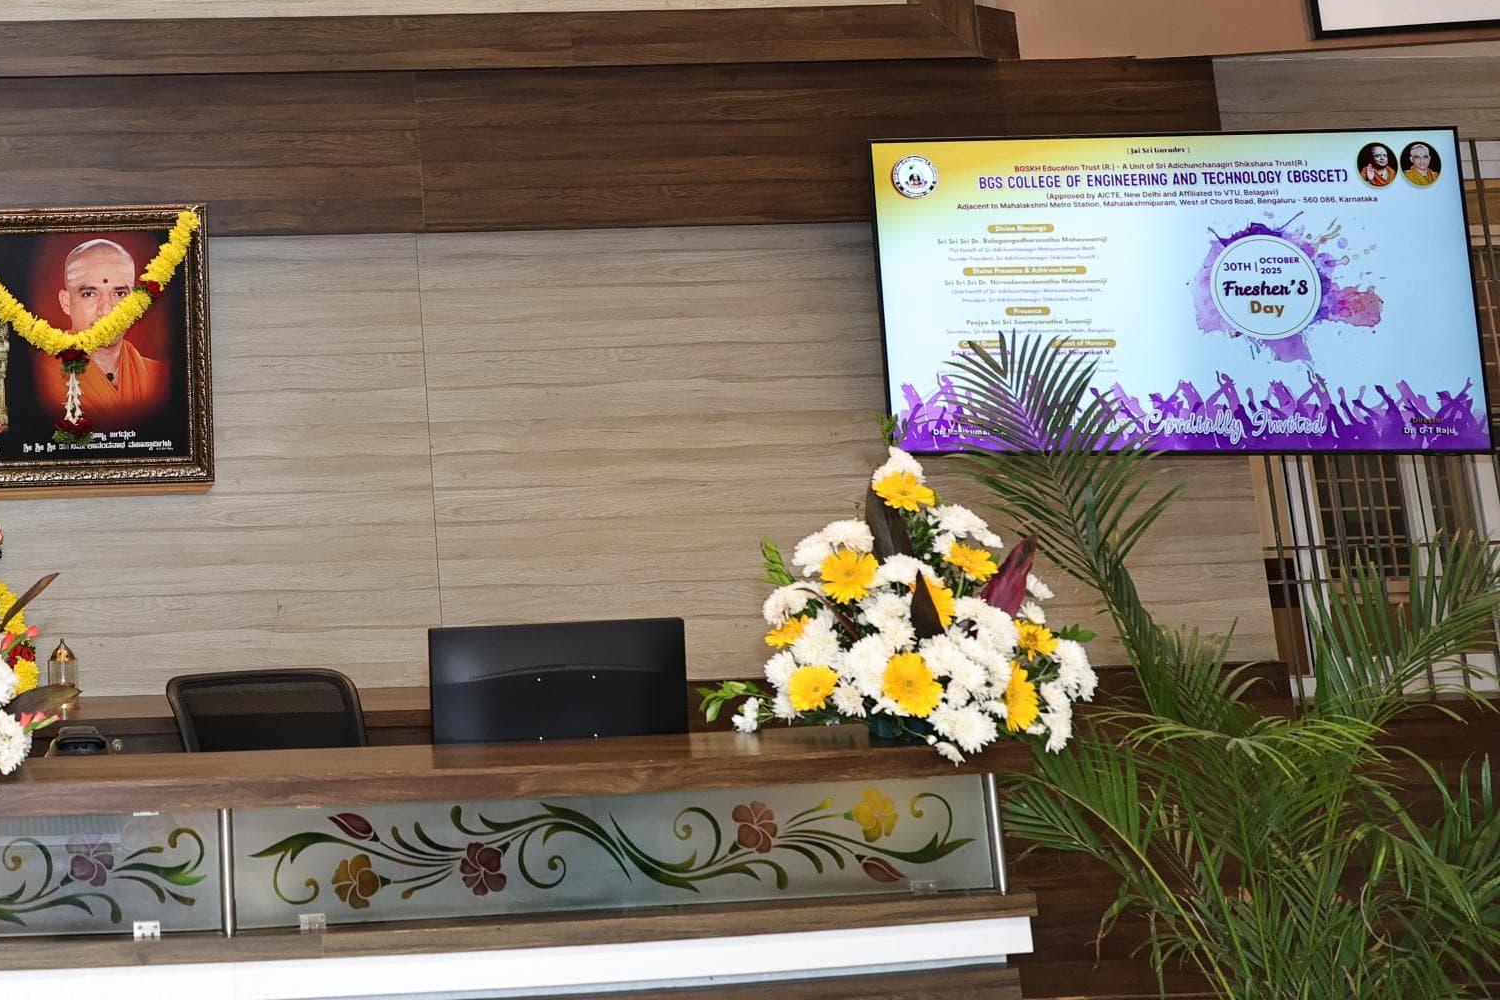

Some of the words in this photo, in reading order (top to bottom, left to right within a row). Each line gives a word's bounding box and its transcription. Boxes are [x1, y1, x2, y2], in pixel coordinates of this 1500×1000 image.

[1014, 165, 1041, 173] BGSKH
[1042, 164, 1079, 172] Education
[1168, 161, 1233, 170] Adichunchanagiri
[1234, 160, 1272, 168] Shikshana
[978, 176, 1003, 190] BGS
[1007, 175, 1061, 189] COLLEGE
[1066, 174, 1081, 188] OF
[1086, 172, 1168, 187] ENGINEERING
[1172, 172, 1197, 186] AND
[1201, 170, 1283, 185] TECHNOLOGY
[1287, 168, 1348, 183] (BGSCET)
[1046, 192, 1084, 200] (Approved
[1086, 192, 1096, 200] by
[1142, 190, 1161, 198] Delhi
[1163, 190, 1177, 198] and
[1179, 189, 1213, 197] Affiliated
[1244, 188, 1279, 197] Belagavi)
[957, 203, 989, 211] Adjacent
[1000, 201, 1048, 209] Mahalakshmi
[1073, 200, 1102, 209] Station,
[1179, 198, 1200, 206] West
[1234, 197, 1256, 206] Road,
[1257, 197, 1296, 206] Bengaluru
[1302, 196, 1319, 204] 560
[1338, 195, 1378, 203] Karnataka
[1223, 262, 1252, 271] 30TH
[1259, 256, 1300, 264] OCTOBER
[1260, 267, 1282, 275] 2025
[1250, 300, 1285, 318] Day
[1144, 409, 1245, 445] Cordially
[1251, 410, 1328, 438] Invited
[1435, 426, 1455, 435] Raju
